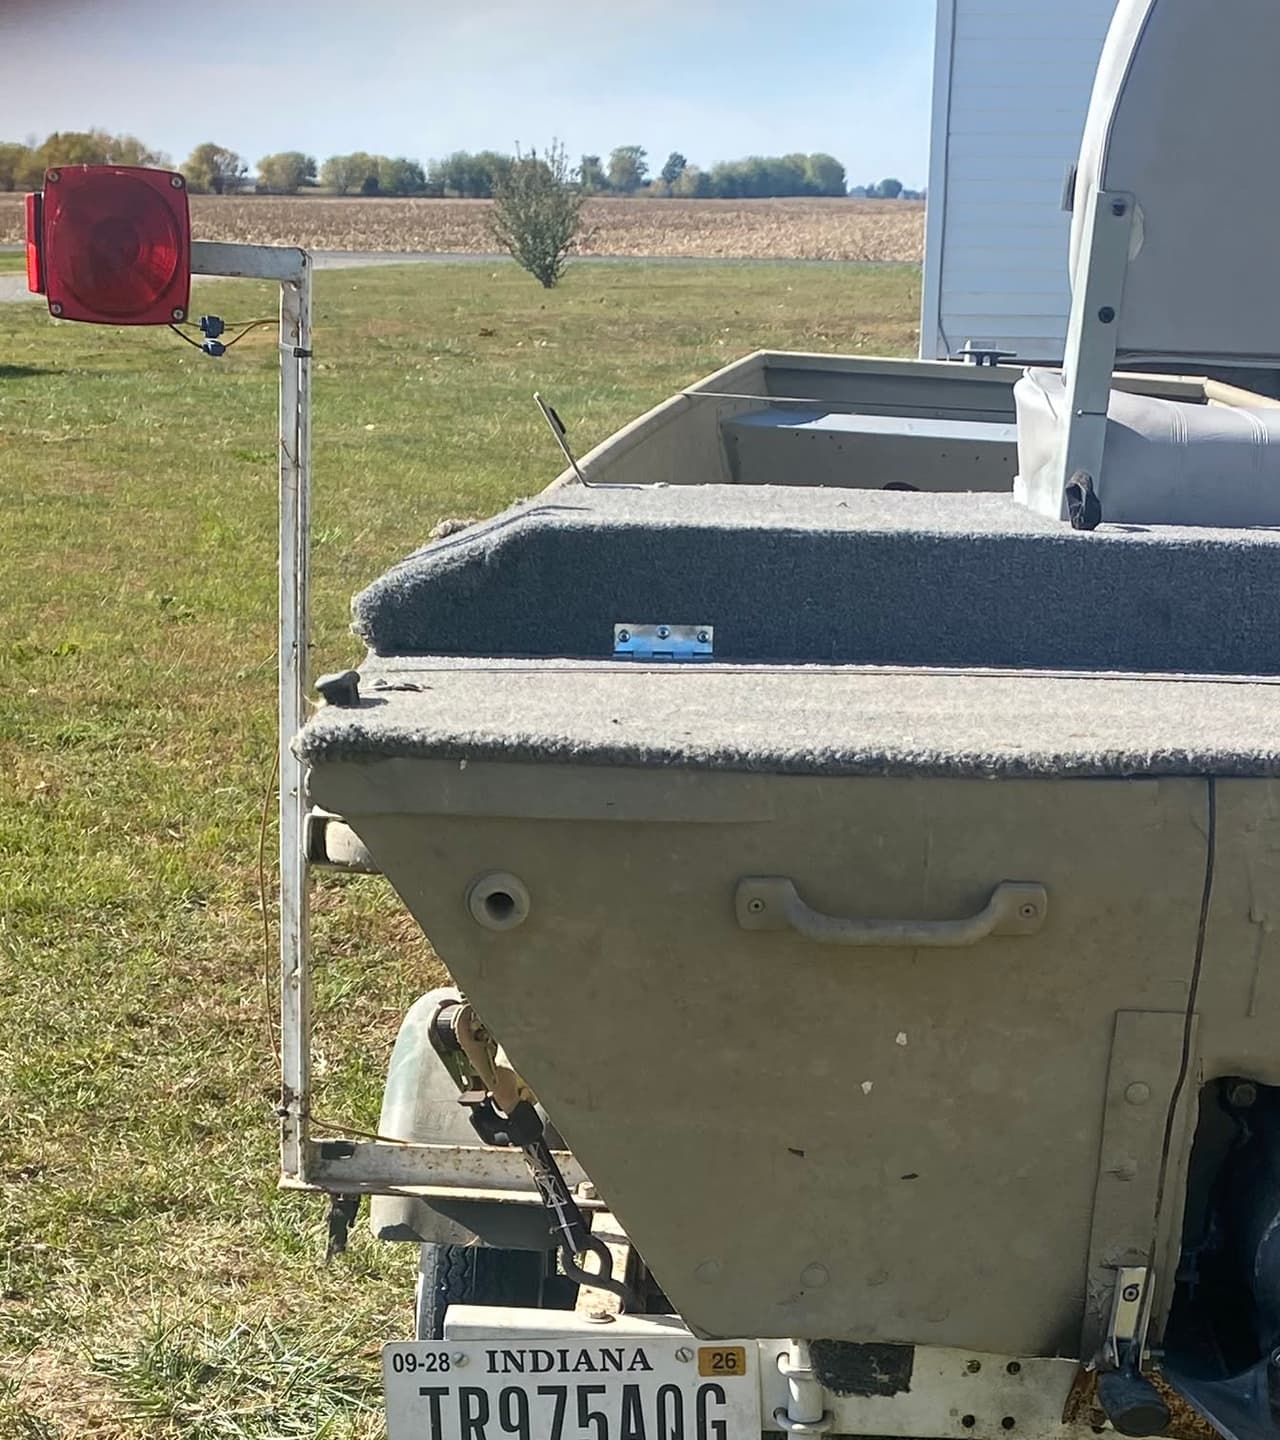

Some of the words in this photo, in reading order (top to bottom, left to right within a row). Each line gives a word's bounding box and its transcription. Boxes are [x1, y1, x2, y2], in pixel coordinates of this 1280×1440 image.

[392, 1352, 451, 1373] 09-28
[485, 1347, 654, 1374] INDIANA
[712, 1352, 737, 1369] 26
